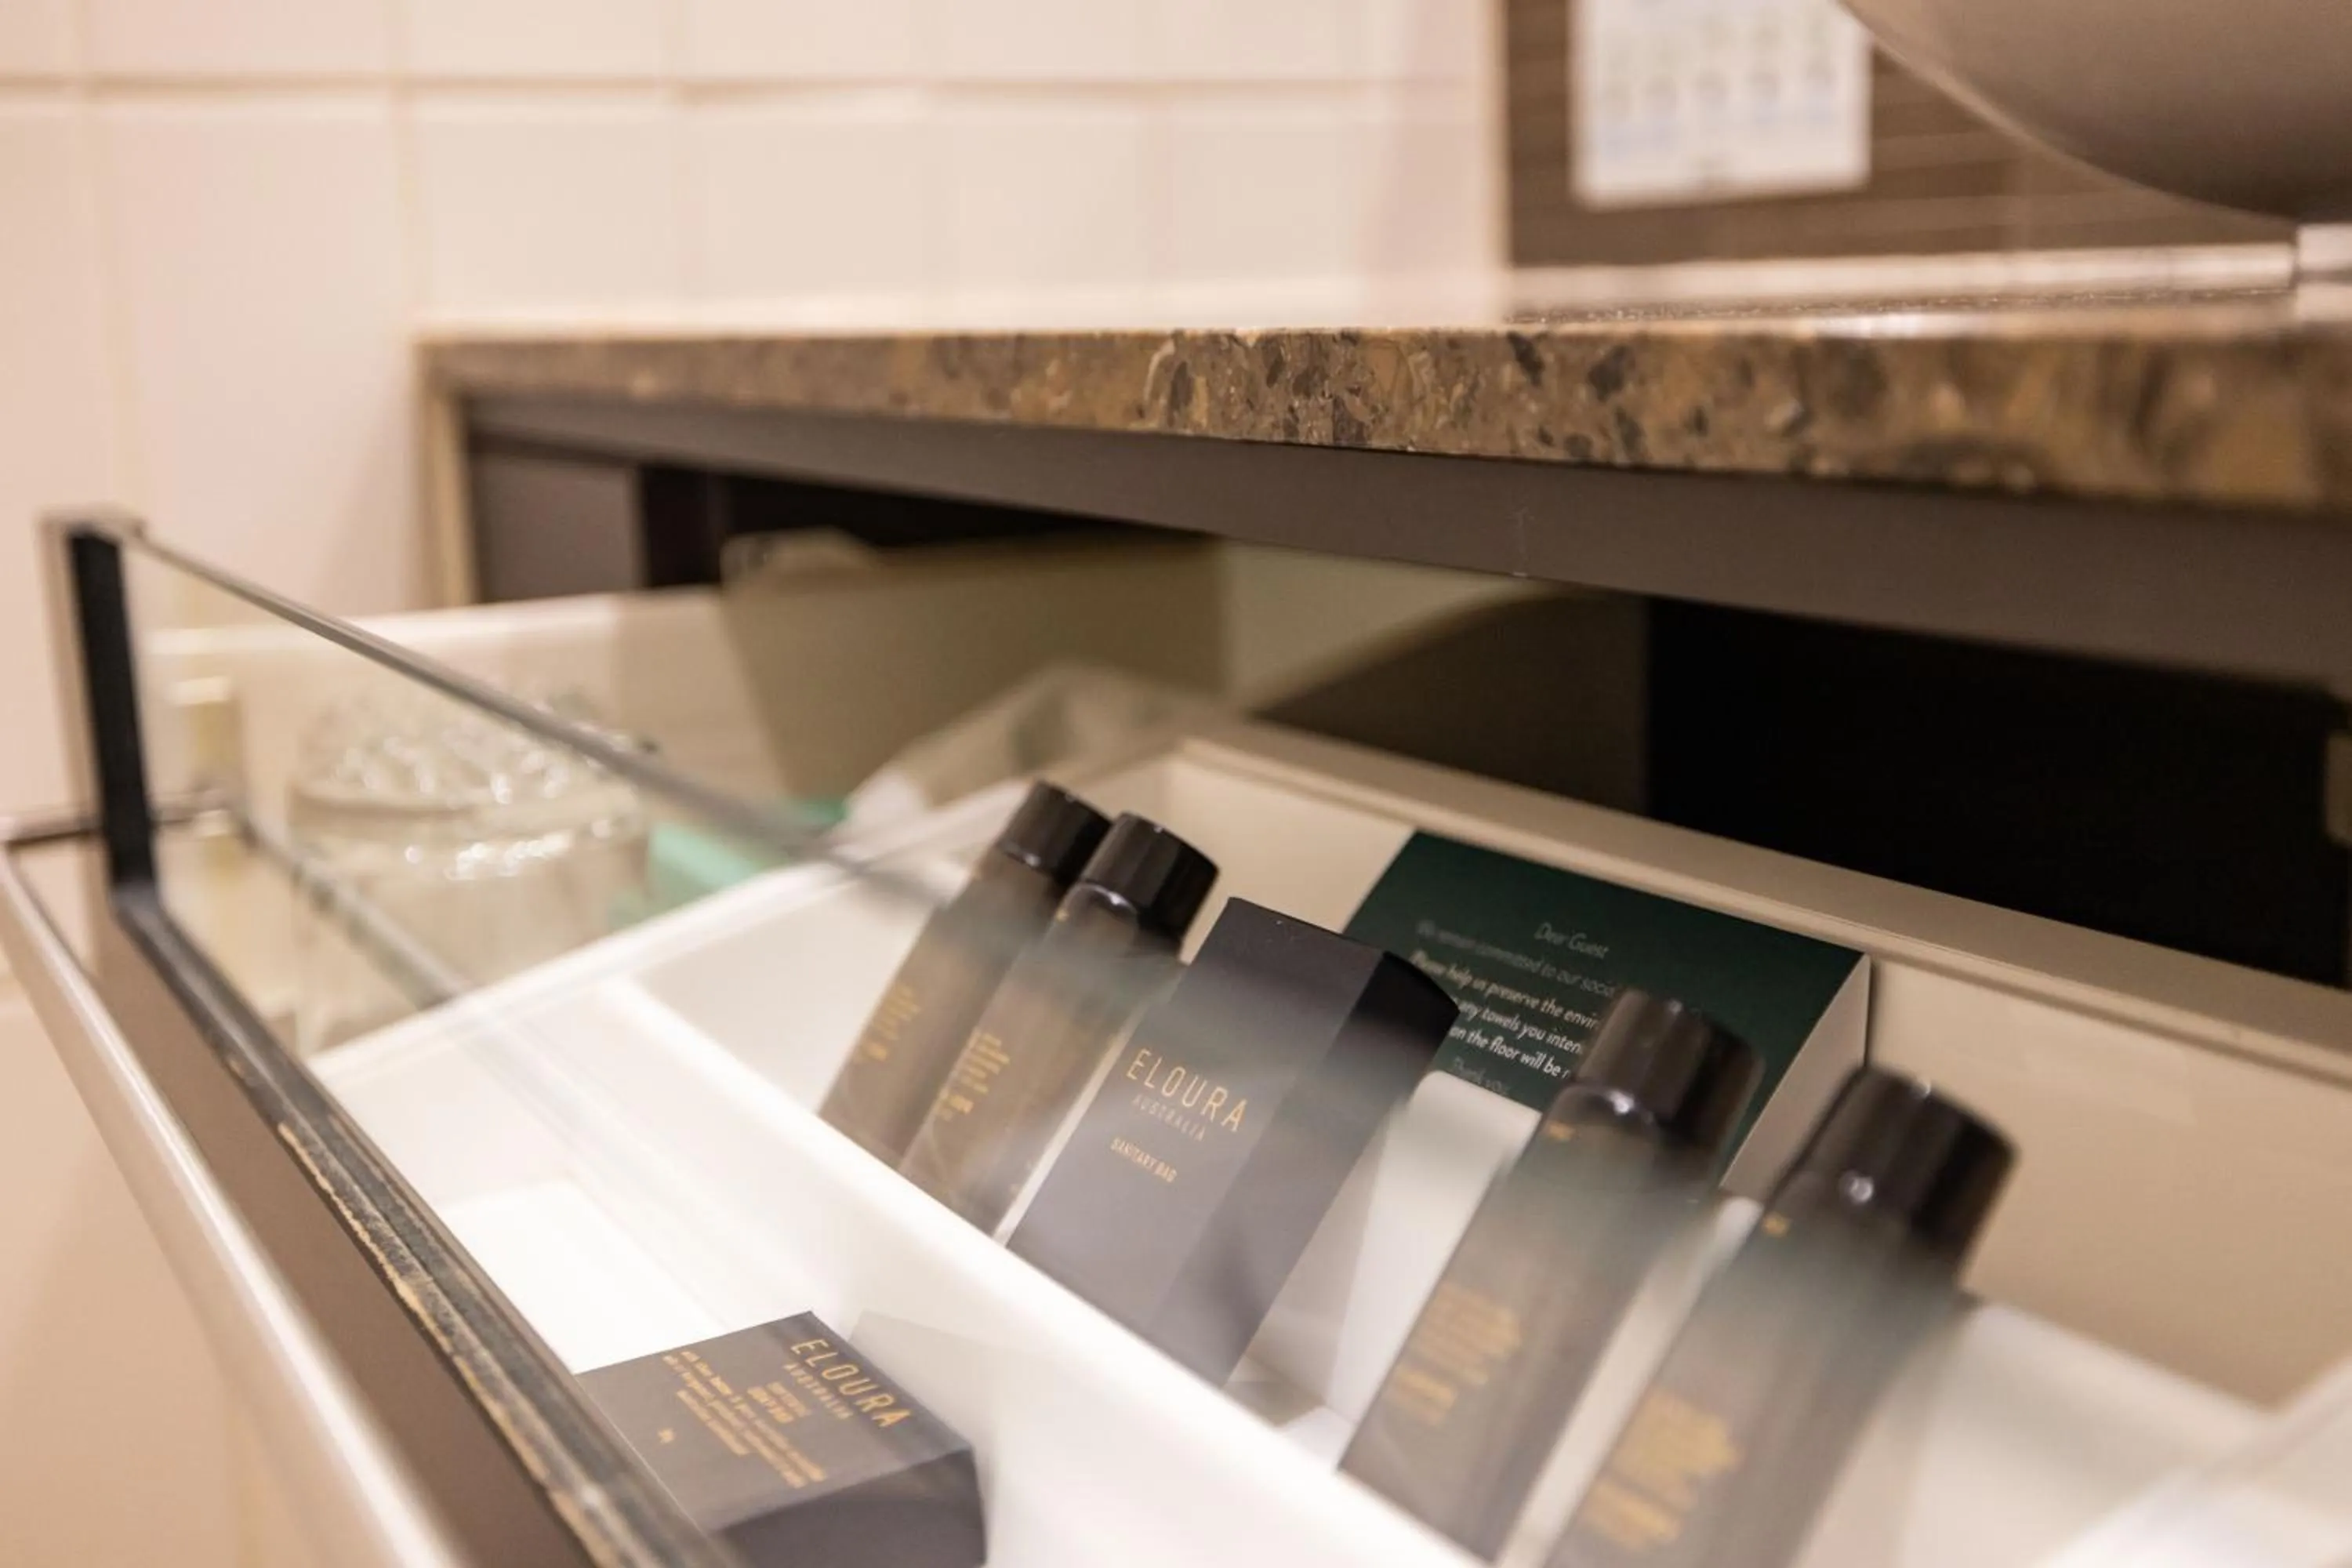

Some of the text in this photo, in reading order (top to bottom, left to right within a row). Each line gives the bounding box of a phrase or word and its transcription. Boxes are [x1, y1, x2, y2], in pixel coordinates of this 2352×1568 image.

[1568, 931, 1610, 959] Guest
[1447, 963, 1472, 990] help
[1483, 982, 1540, 1010] preserve
[1541, 998, 1564, 1017] the
[1556, 970, 1582, 985] our
[1467, 1029, 1489, 1047] the
[1490, 1036, 1520, 1059] floor
[1520, 1051, 1547, 1069] will
[1543, 1055, 1561, 1077] be
[1482, 1007, 1521, 1031] towels
[1516, 1022, 1547, 1040] you
[1546, 1025, 1583, 1054] inten
[1126, 1048, 1248, 1132] ELOURA
[1131, 1094, 1206, 1142] AUSTRALIA
[1109, 1137, 1178, 1183] SANITARY BAG
[790, 1338, 911, 1428] ELOURA
